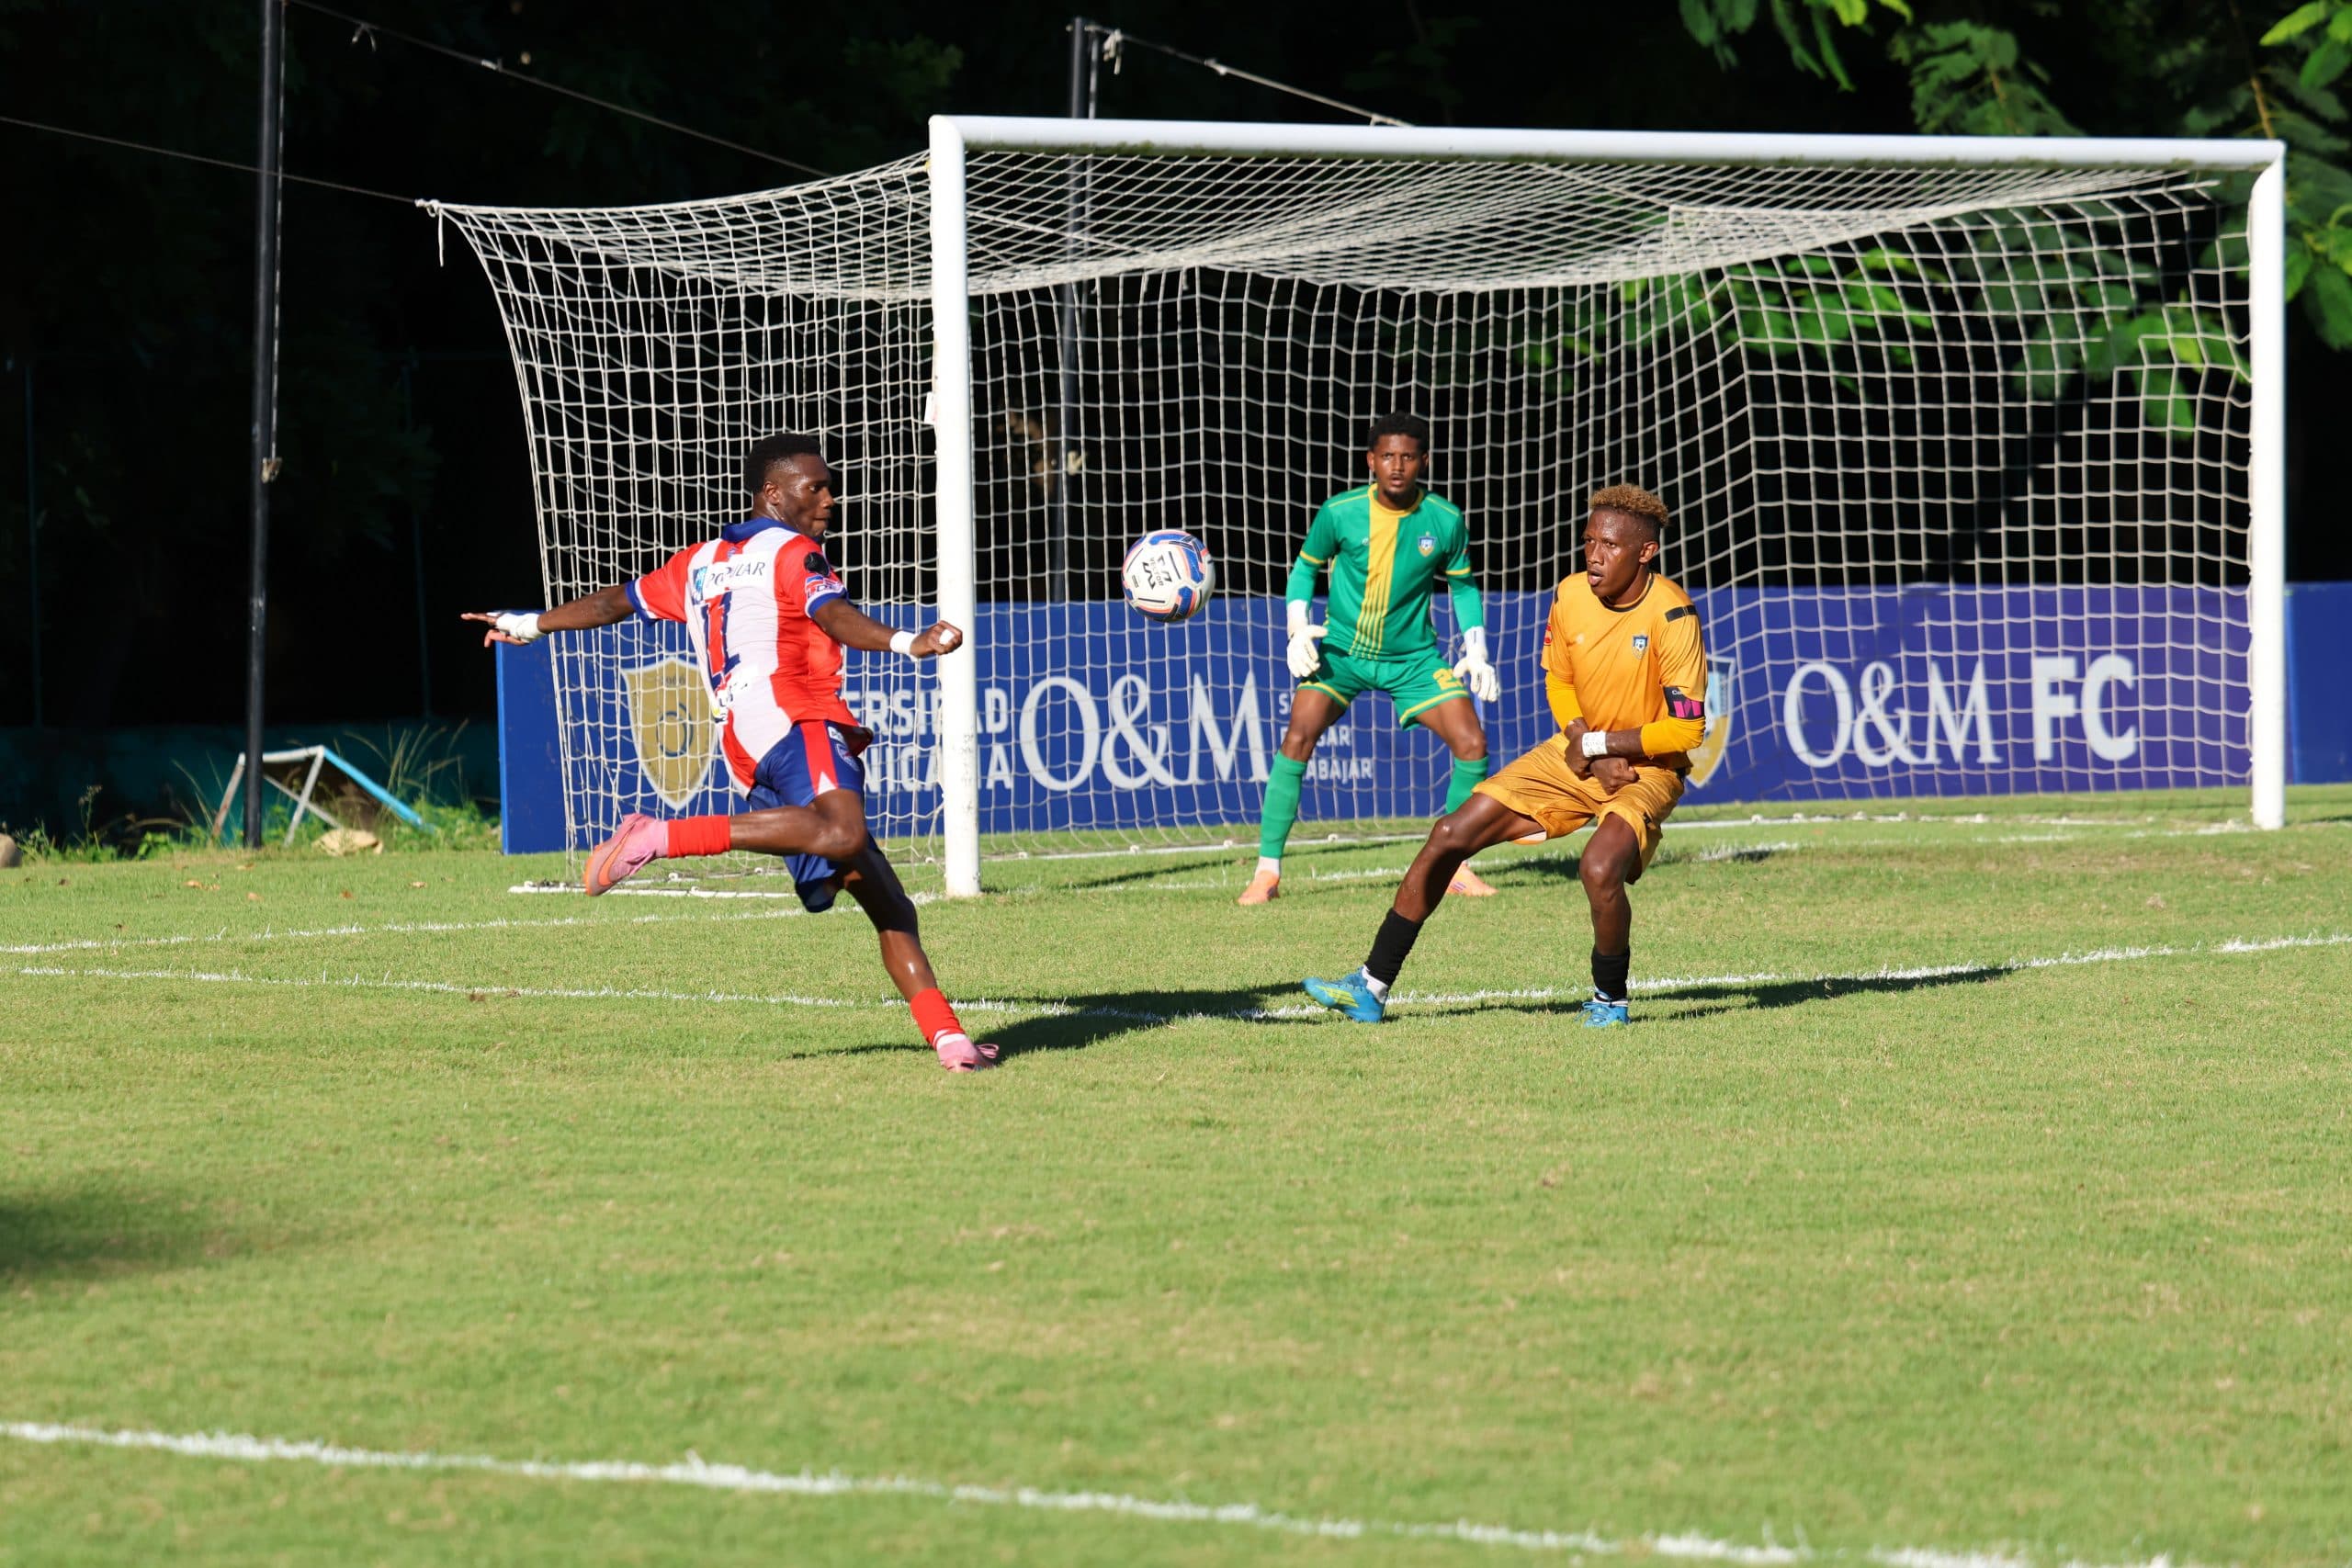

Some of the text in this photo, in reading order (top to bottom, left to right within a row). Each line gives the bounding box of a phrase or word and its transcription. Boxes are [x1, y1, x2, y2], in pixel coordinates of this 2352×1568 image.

[1019, 670, 1271, 793] O&M
[1783, 654, 2136, 769] O&M FC
